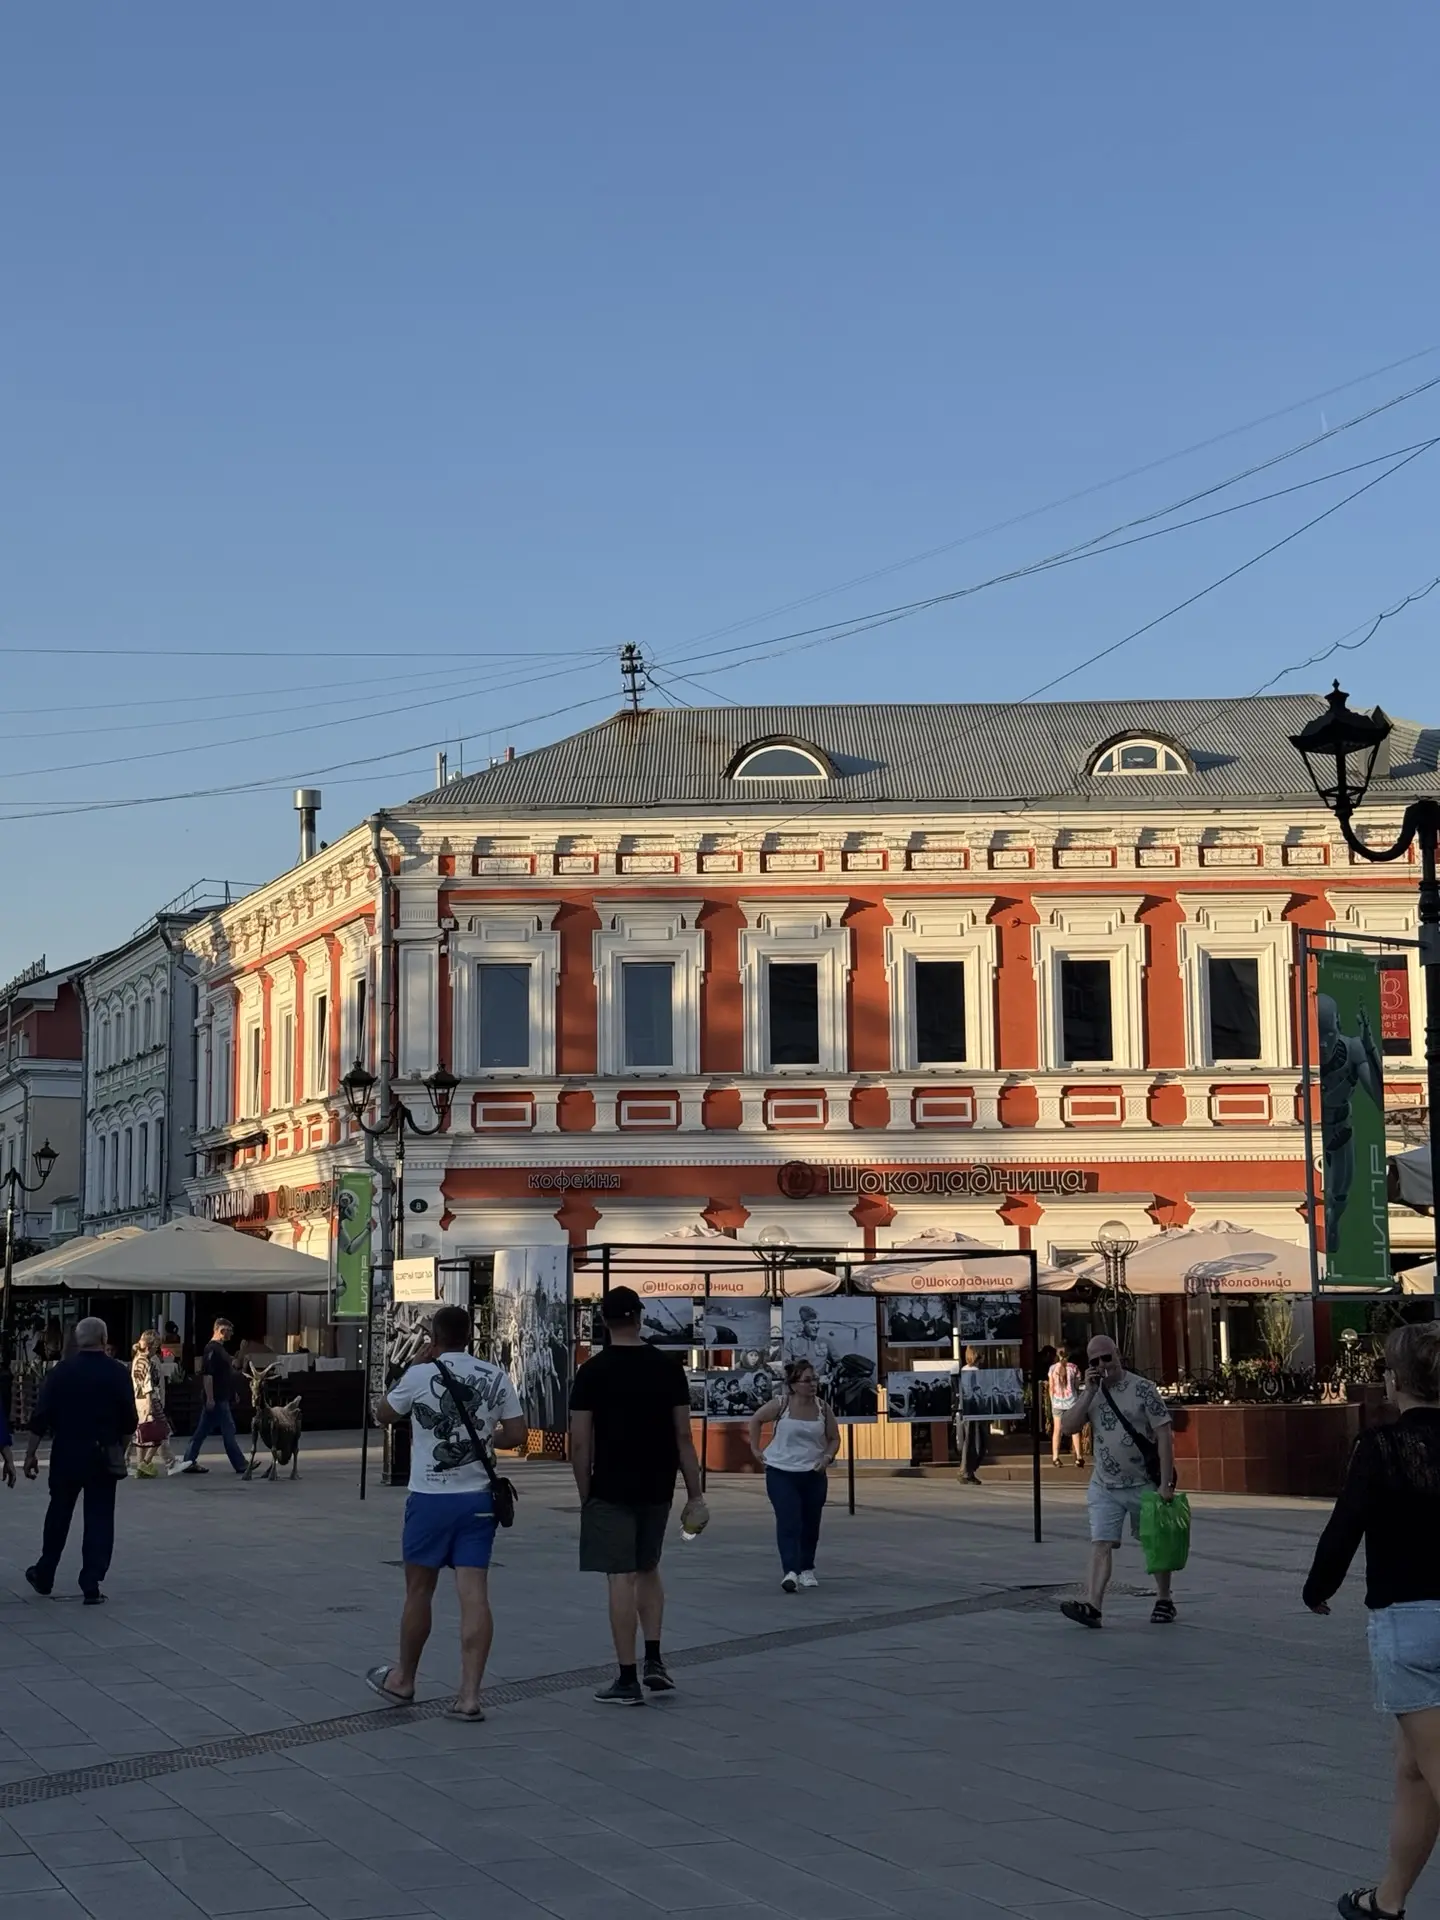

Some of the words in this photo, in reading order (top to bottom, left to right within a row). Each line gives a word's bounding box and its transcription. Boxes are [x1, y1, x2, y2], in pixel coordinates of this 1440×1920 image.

[528, 1170, 621, 1193] кофейня
[827, 1164, 1086, 1195] Шоколадница
[926, 1275, 1013, 1288] Шоколадница
